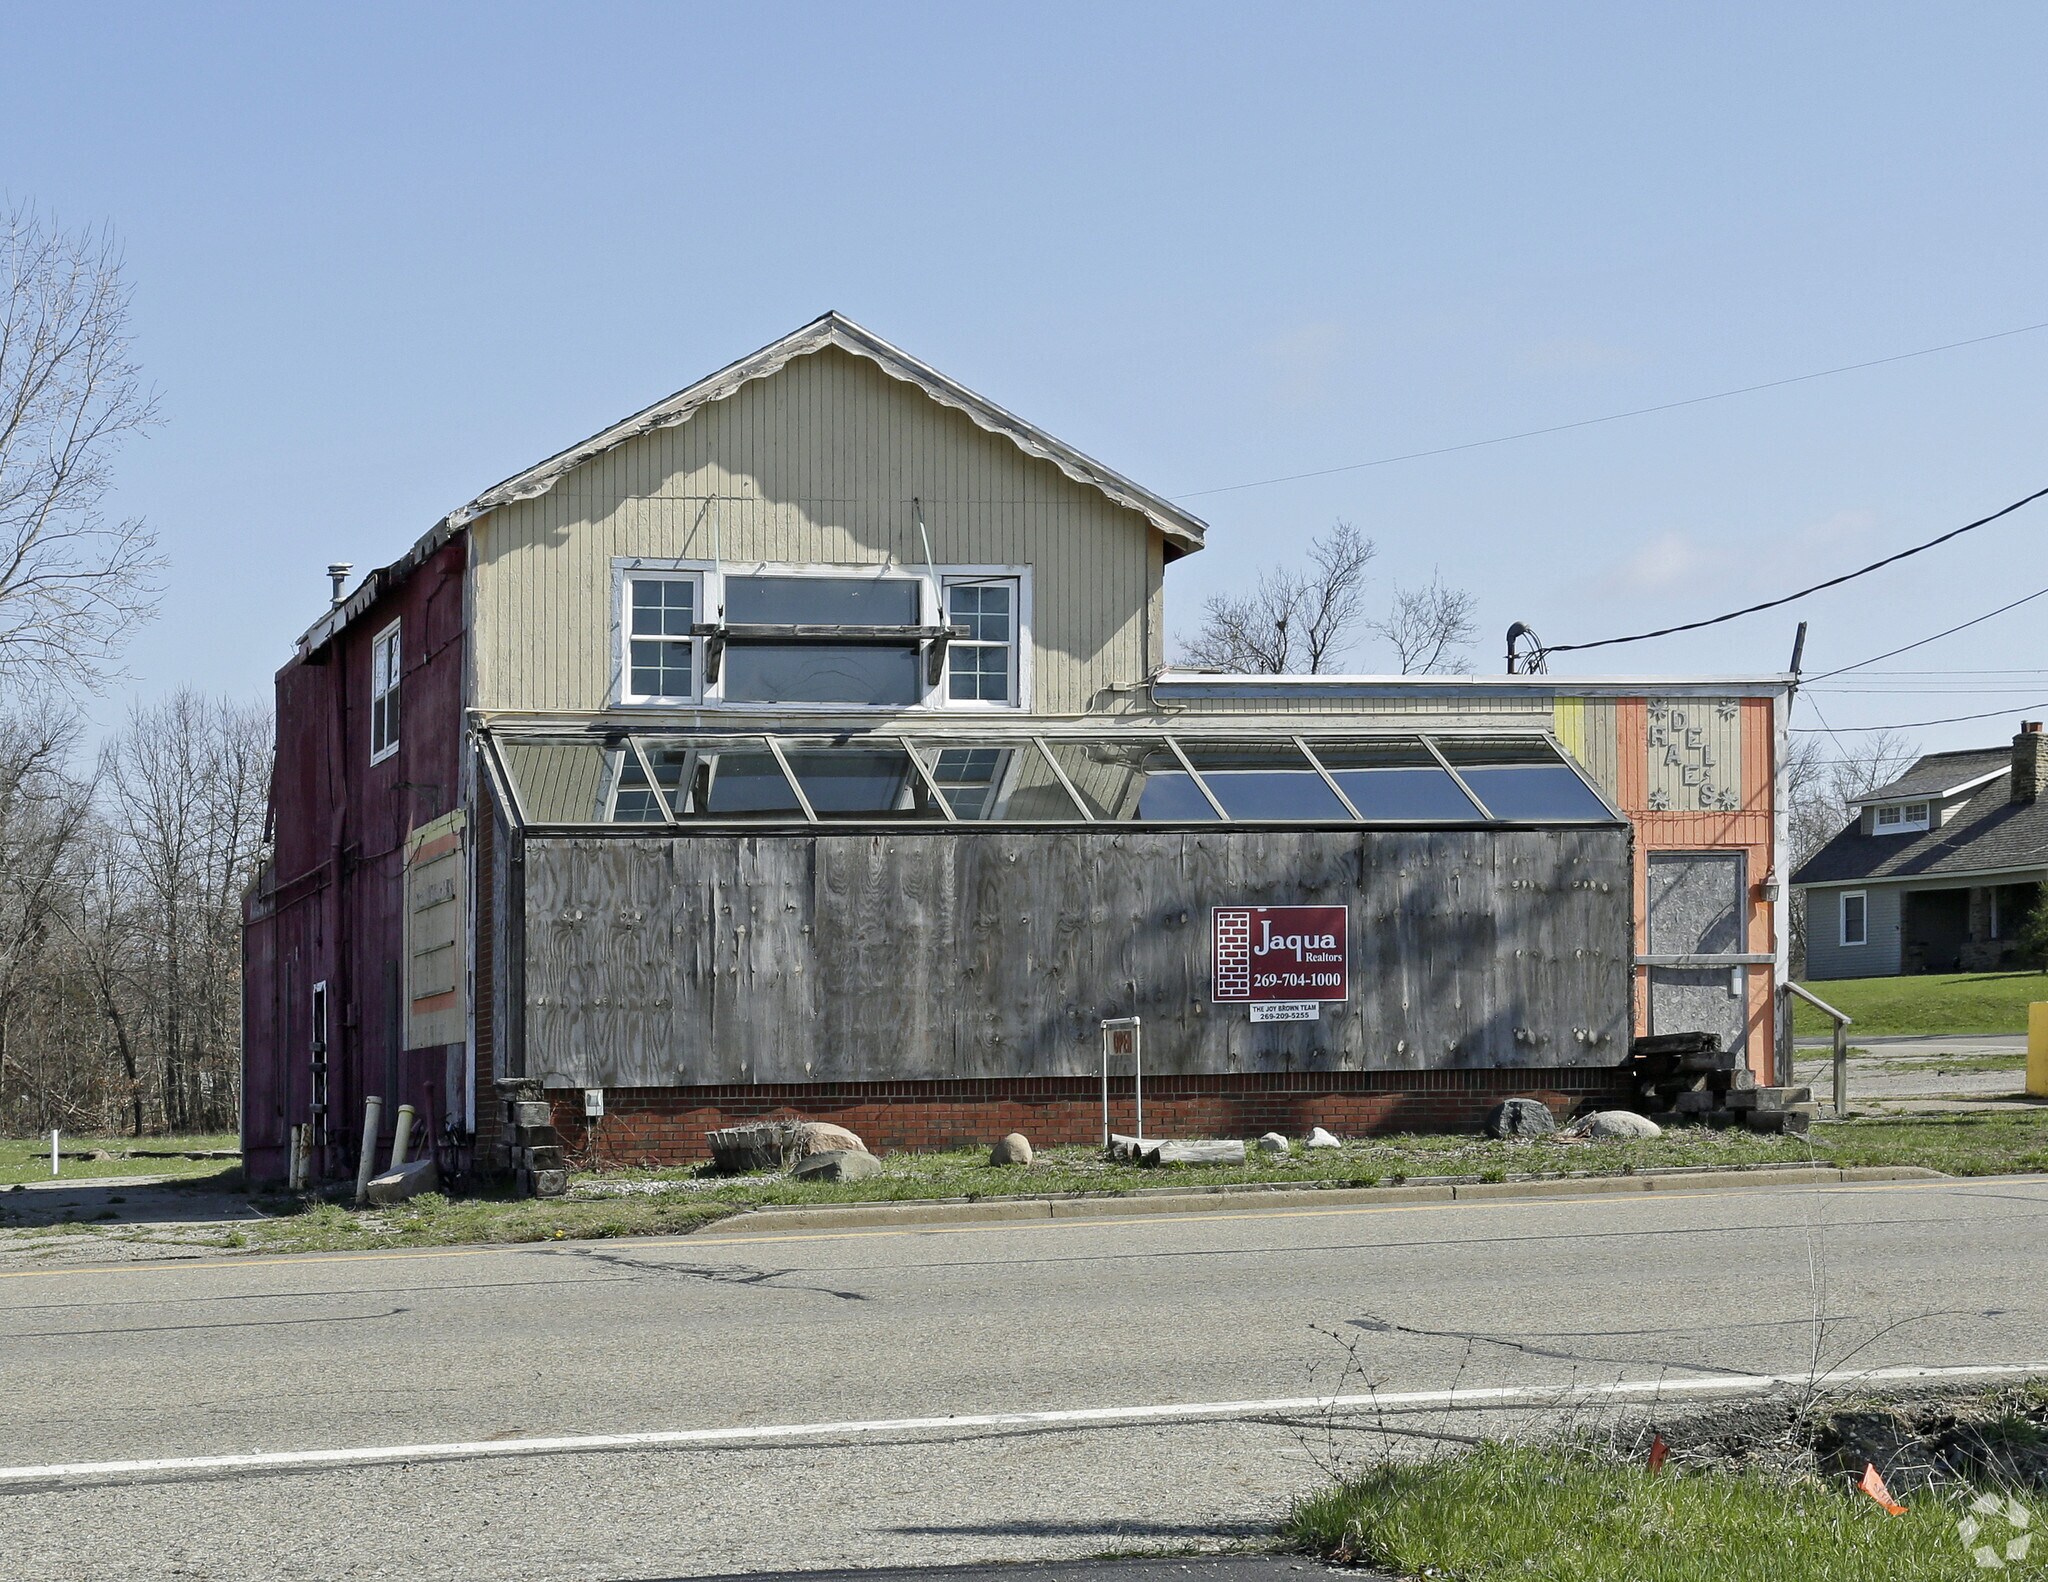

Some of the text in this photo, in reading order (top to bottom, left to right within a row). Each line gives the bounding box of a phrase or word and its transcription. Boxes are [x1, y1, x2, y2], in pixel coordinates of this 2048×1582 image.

[1254, 920, 1336, 962] Jaqua
[1305, 952, 1343, 962] Realtors
[1253, 973, 1341, 987] 269-704-1000
